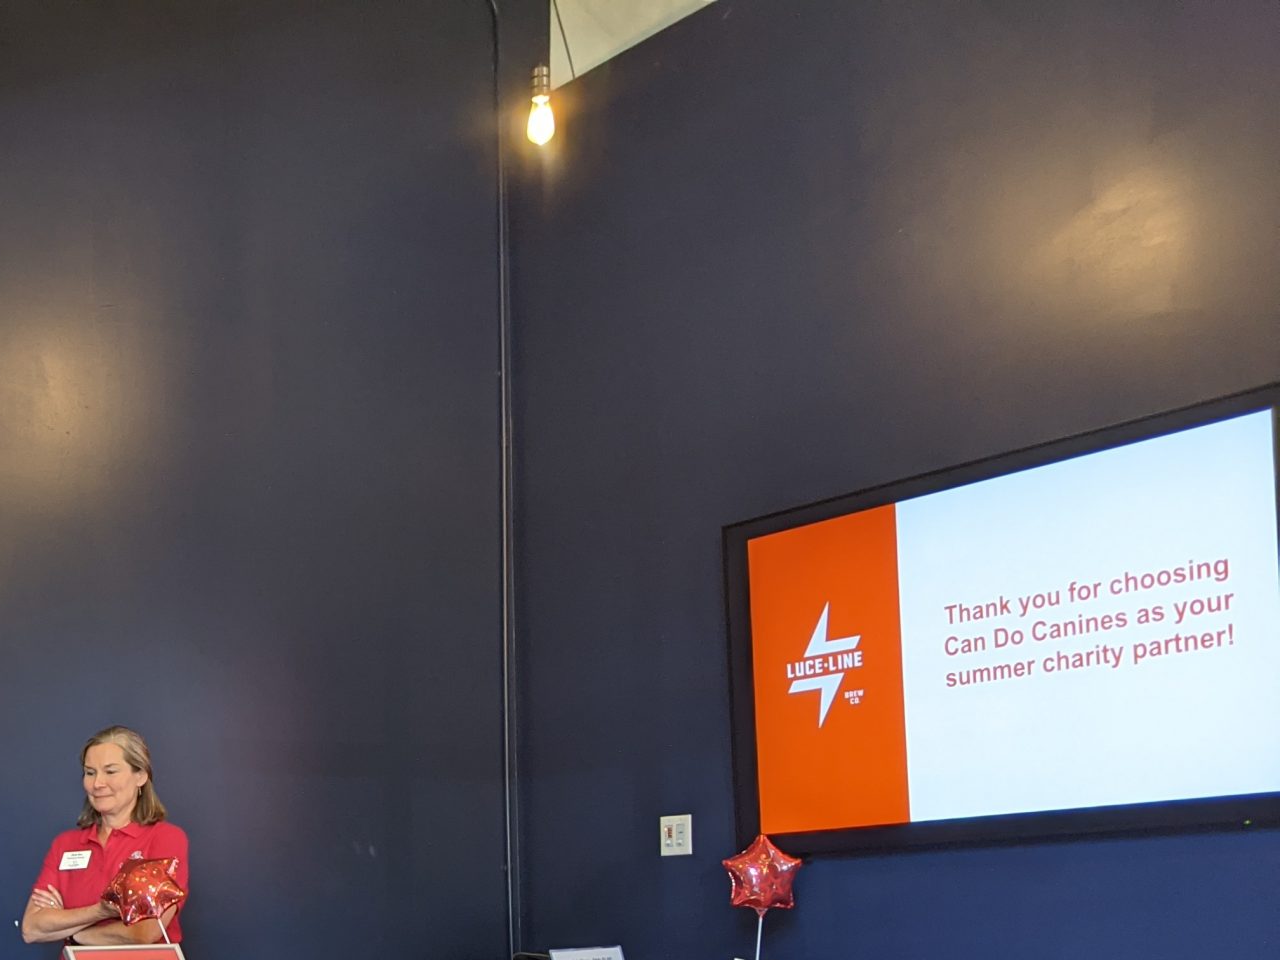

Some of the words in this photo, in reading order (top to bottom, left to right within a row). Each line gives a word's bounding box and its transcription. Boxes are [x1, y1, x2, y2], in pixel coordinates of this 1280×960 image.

[944, 595, 1012, 625] Thank
[1018, 590, 1061, 617] you
[1068, 581, 1102, 603] for
[1110, 558, 1230, 596] choosing
[944, 635, 986, 656] Can
[994, 627, 1024, 649] Do
[1032, 611, 1128, 642] Canines
[1137, 605, 1165, 625] as
[1173, 592, 1235, 624] your
[945, 659, 1036, 688] summer
[1042, 644, 1124, 673] charity
[1133, 623, 1235, 665] partner!
[844, 689, 864, 699] BREW
